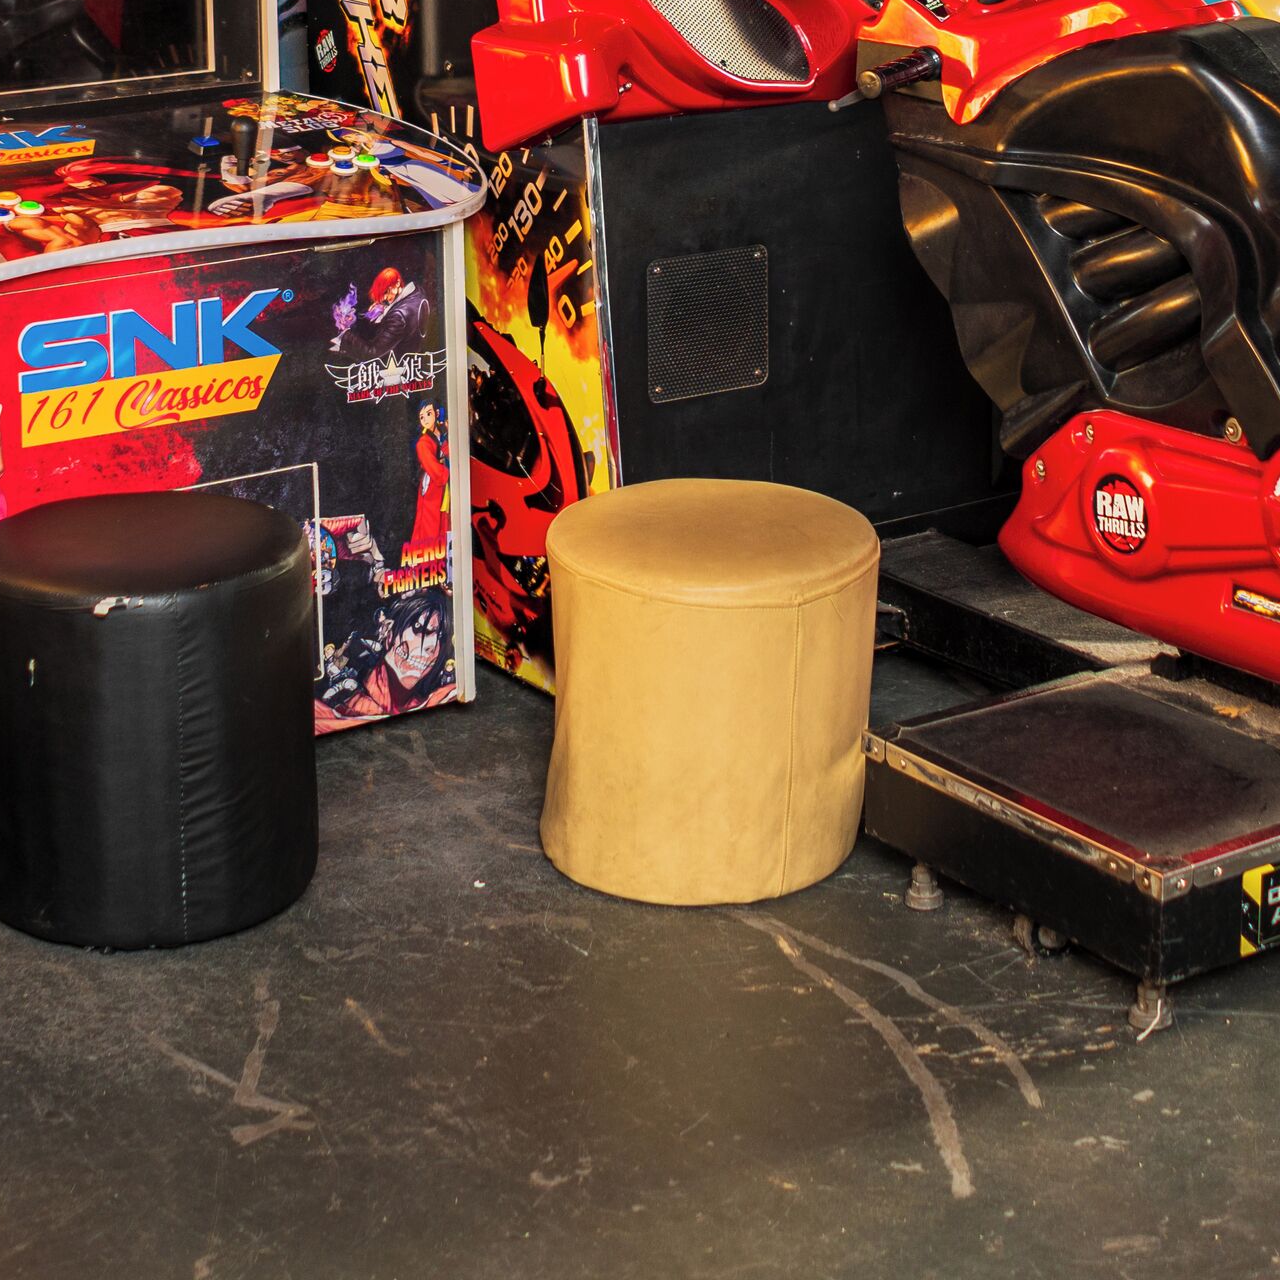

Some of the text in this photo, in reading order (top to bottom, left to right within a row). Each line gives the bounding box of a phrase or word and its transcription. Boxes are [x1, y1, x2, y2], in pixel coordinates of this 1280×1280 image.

[316, 30, 335, 61] RAW
[487, 150, 513, 201] 120
[507, 181, 543, 244] 130
[486, 221, 509, 264] 200
[18, 289, 282, 394] SNK
[115, 371, 267, 430] Classicos
[1095, 489, 1145, 522] RAW
[1097, 515, 1146, 540] THRILLS
[400, 534, 447, 568] AERO
[383, 561, 447, 599] FIGHTERS
